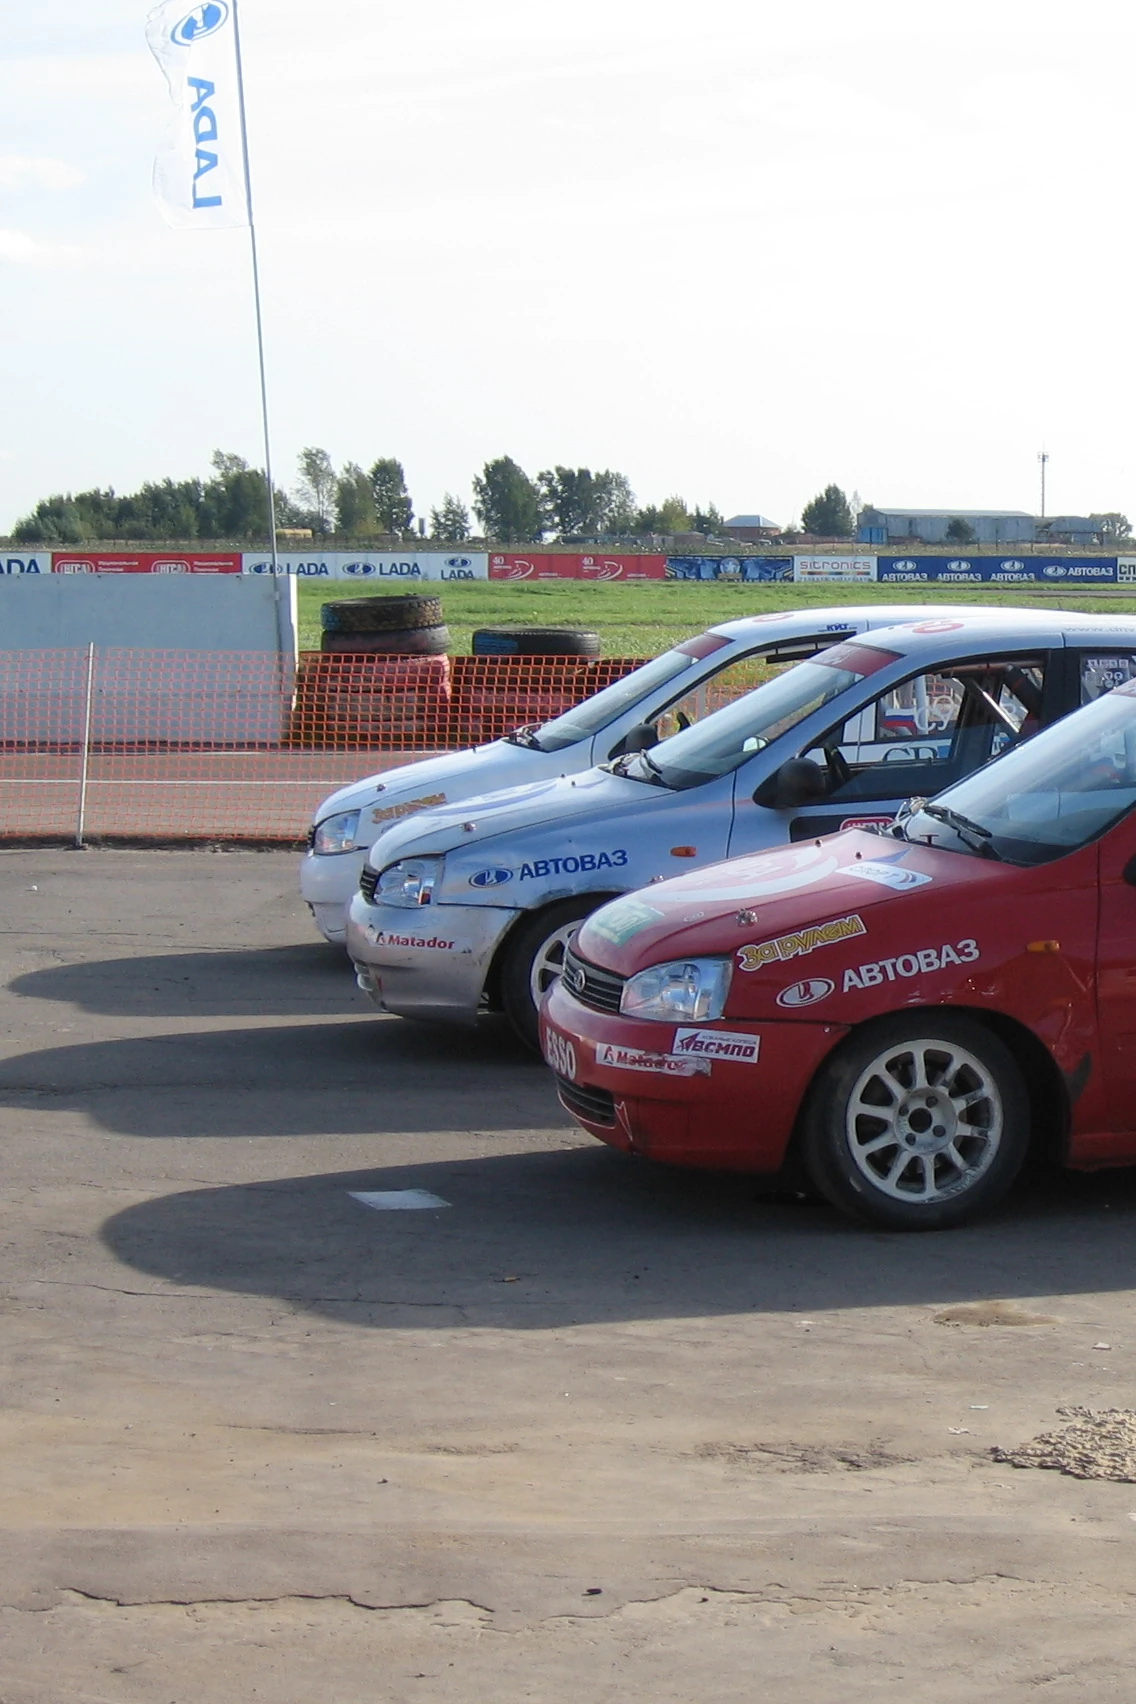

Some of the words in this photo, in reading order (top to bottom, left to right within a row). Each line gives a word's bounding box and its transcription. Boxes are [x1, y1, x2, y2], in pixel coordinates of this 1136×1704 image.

[286, 562, 329, 576] LADA
[379, 562, 421, 576] LADA
[441, 569, 474, 581] LADA
[1067, 567, 1113, 576] АВТОВАЗ
[882, 573, 928, 582] АВТОВАЗ
[937, 573, 982, 582] АВТОВАЗ
[990, 573, 1035, 582] АВТОВАЗ
[519, 850, 629, 881] АВТОВАЗ
[388, 934, 456, 950] Matador
[737, 941, 777, 971] За
[842, 939, 981, 993] АВТОВАЗ
[692, 1040, 755, 1058] ВСМПО
